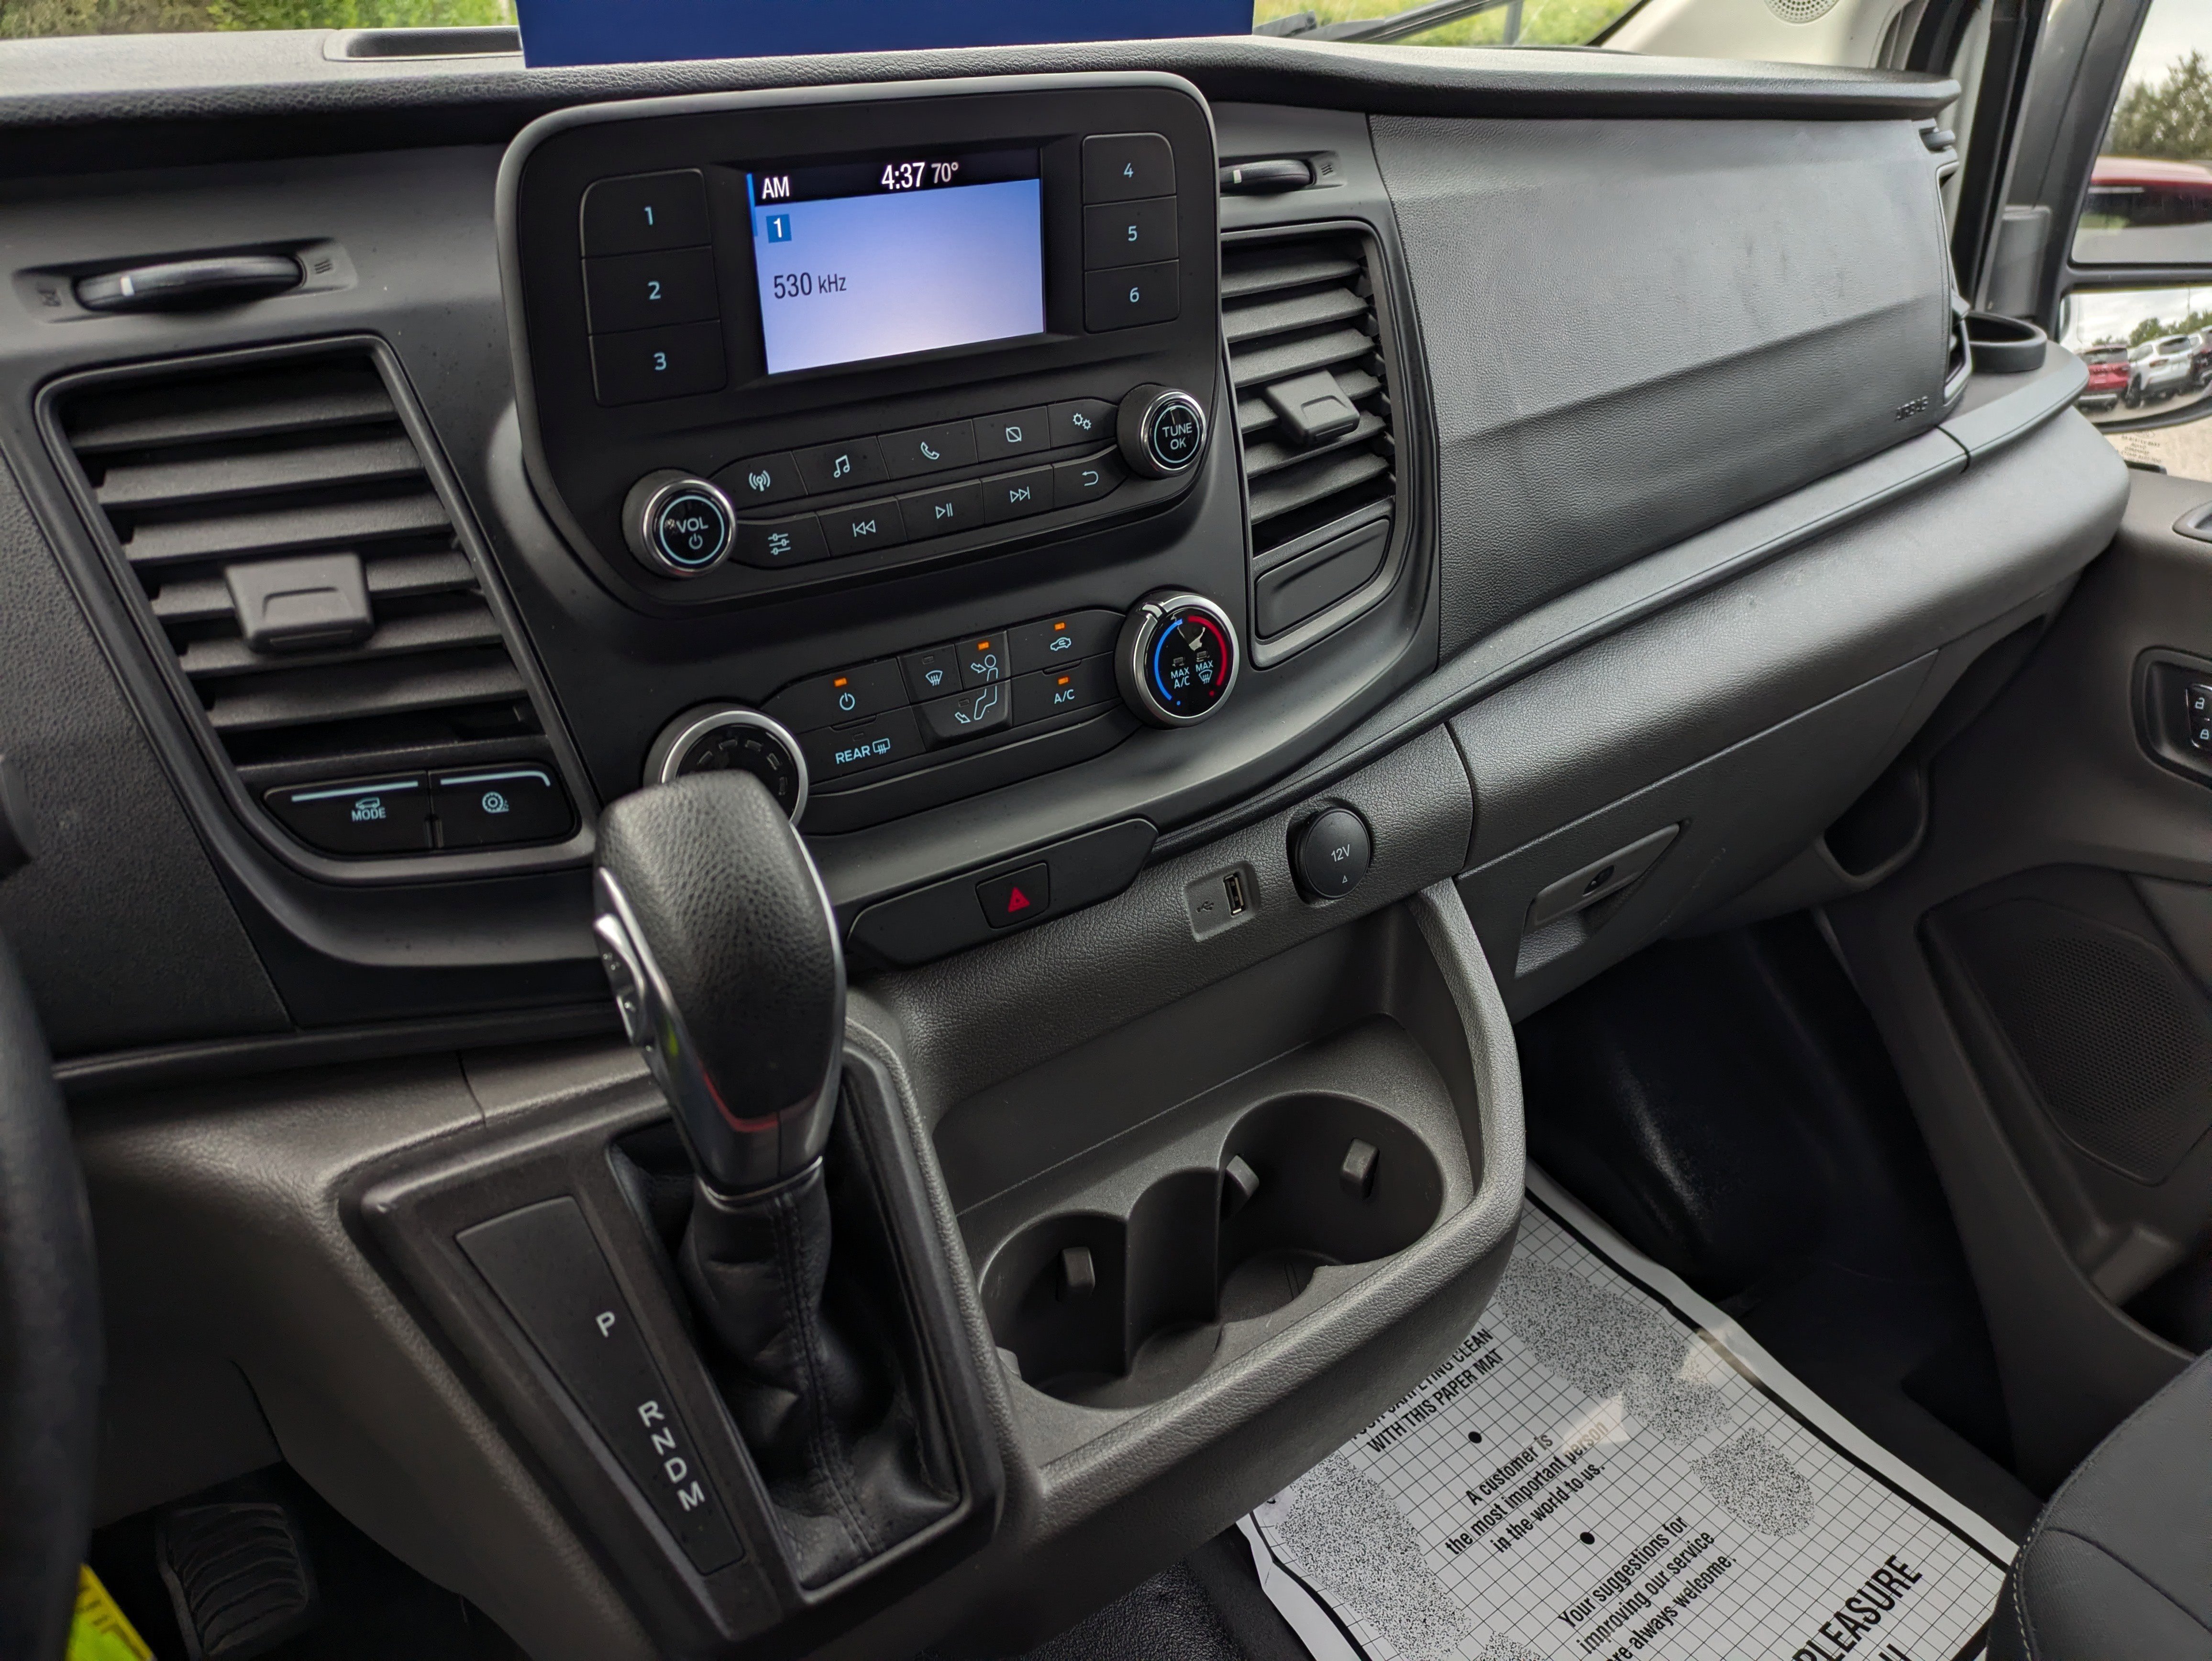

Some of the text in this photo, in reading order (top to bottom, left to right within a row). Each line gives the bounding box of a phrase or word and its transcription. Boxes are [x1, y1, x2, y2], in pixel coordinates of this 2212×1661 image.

[882, 161, 959, 190] 4:37 70°
[1124, 163, 1134, 178] 4
[762, 176, 790, 199] AM
[644, 207, 653, 225] 1
[774, 218, 783, 238] 1
[1128, 225, 1138, 241] 5
[648, 281, 661, 299] 2
[773, 272, 847, 299] 530 kHz
[1129, 287, 1139, 303] 6
[654, 352, 667, 370] 3
[1161, 422, 1193, 438] TUNE
[1170, 437, 1186, 450] OK
[675, 517, 708, 533] VOL
[1171, 667, 1190, 679] MAX
[1195, 660, 1214, 672] MAX
[1174, 675, 1190, 689] A/C
[1054, 689, 1075, 704] A/C
[835, 745, 871, 764] REAR
[351, 807, 386, 821] MODE
[1331, 843, 1350, 862] 12V
[596, 1311, 615, 1337] P
[1452, 1328, 1493, 1362] CLEAN
[1366, 1421, 1407, 1452] WITH
[1401, 1399, 1437, 1427] THIS
[1432, 1369, 1478, 1406] PAPER
[1472, 1348, 1504, 1375] MAT
[638, 1400, 664, 1427] R
[652, 1427, 676, 1455] N
[664, 1457, 687, 1483] D
[1466, 1435, 1553, 1506] A customer is
[677, 1481, 705, 1511] M
[1445, 1421, 1609, 1555] the most important person
[1490, 1464, 1605, 1553] in the world to us.
[1558, 1516, 1688, 1628] Your suggestions for
[1576, 1532, 1715, 1654] improving our service
[1606, 1555, 1737, 1661] re always welcome.
